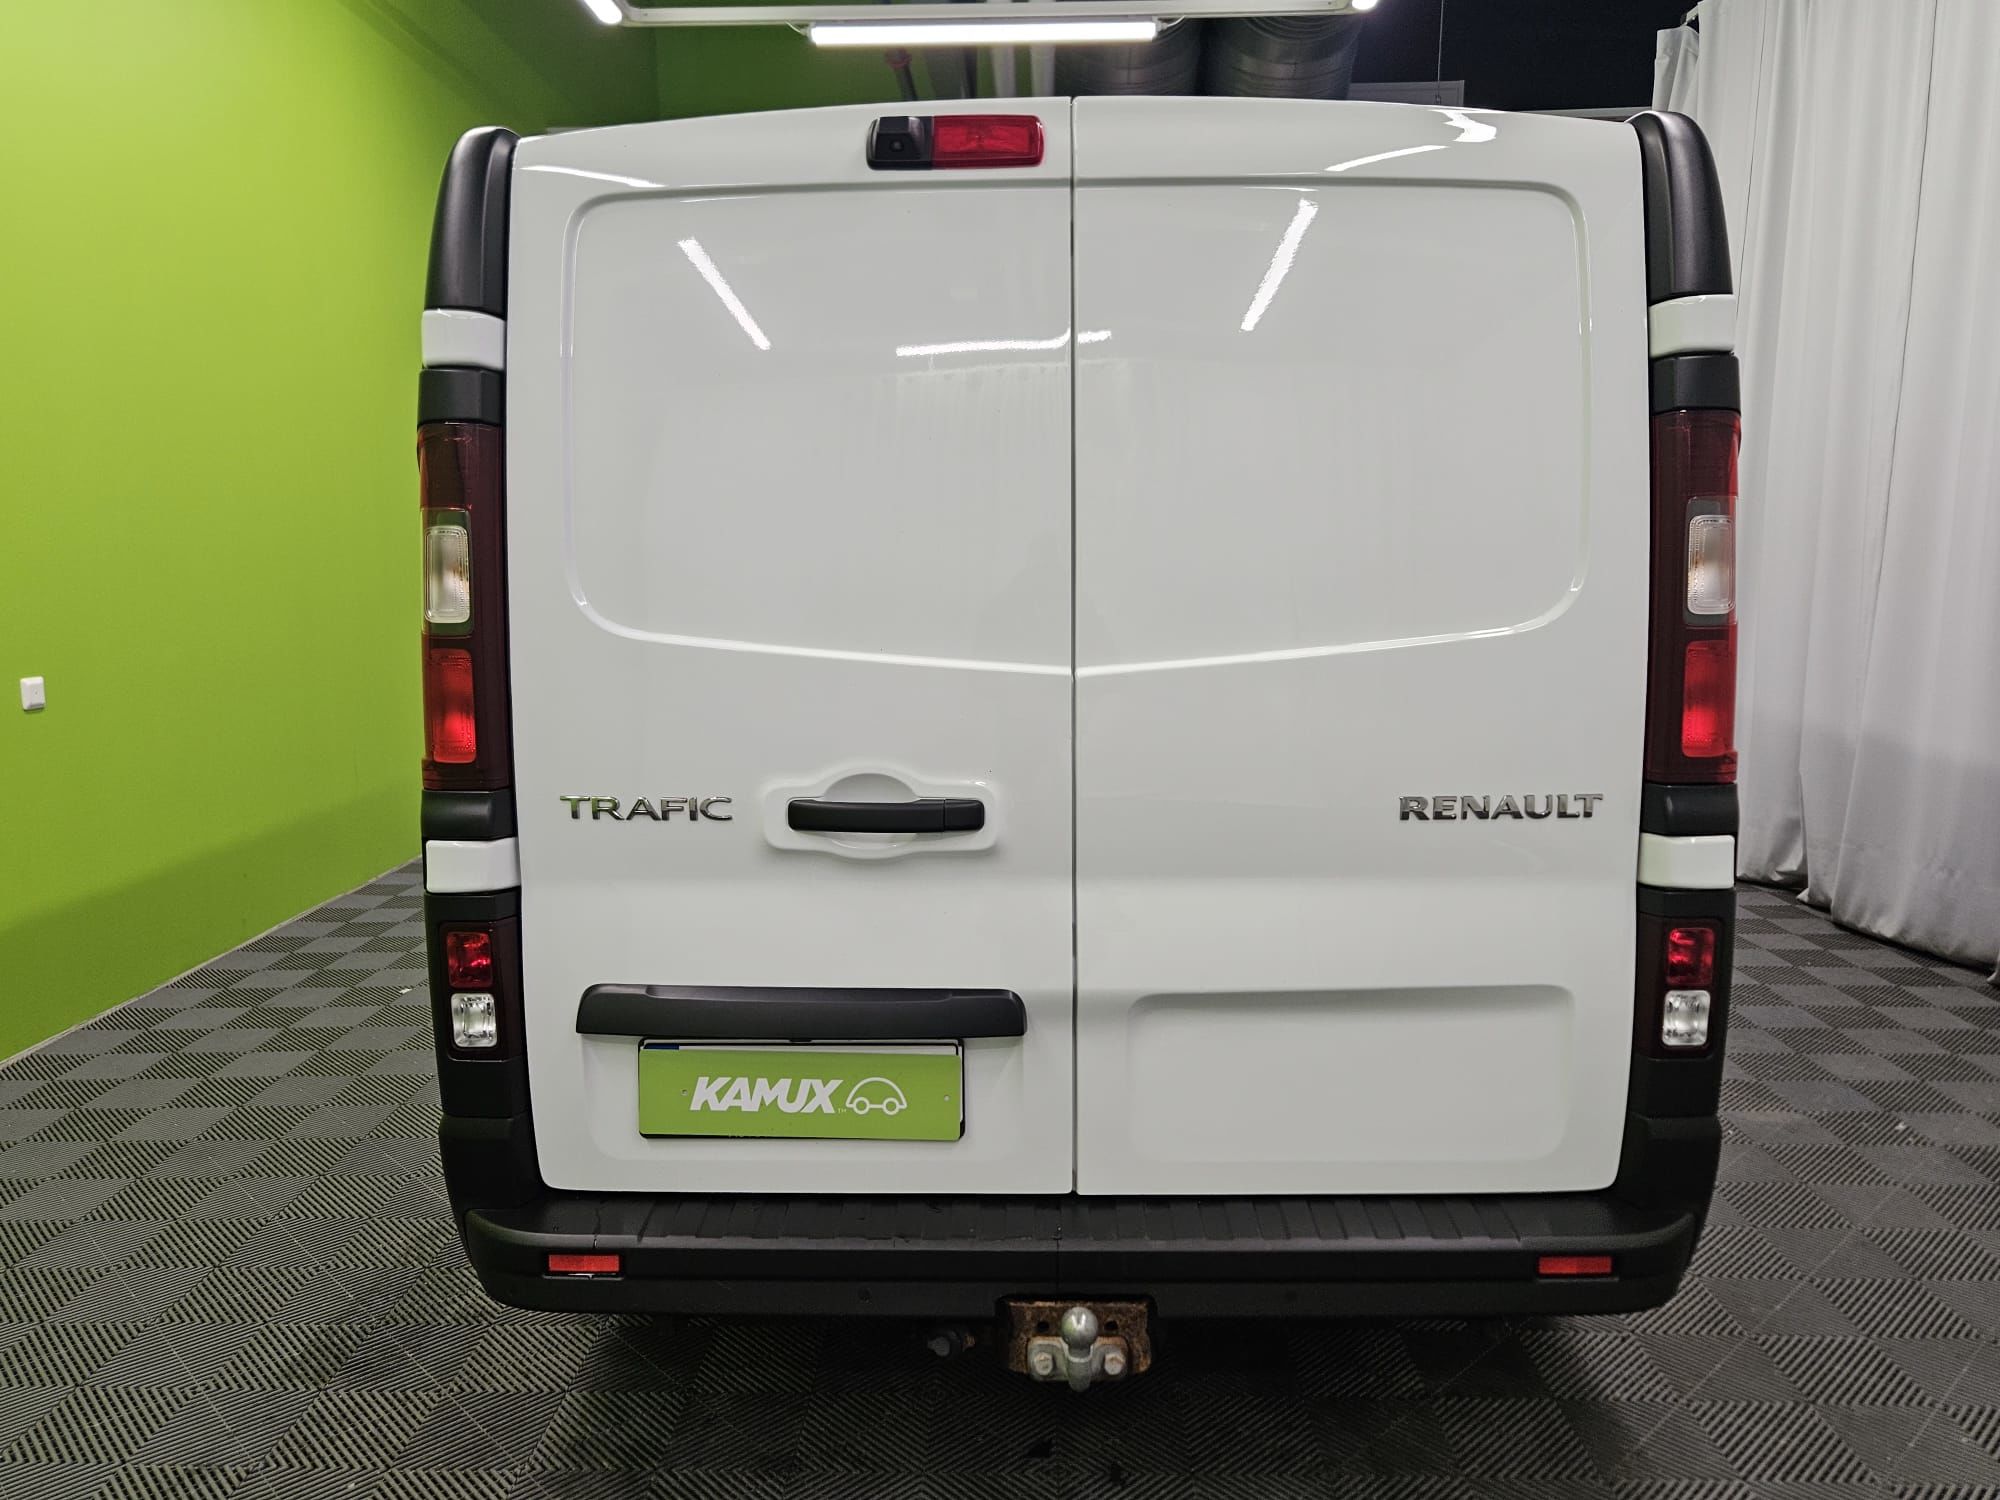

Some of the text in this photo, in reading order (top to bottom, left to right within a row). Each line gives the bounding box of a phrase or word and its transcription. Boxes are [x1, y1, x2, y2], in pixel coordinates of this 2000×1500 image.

[560, 795, 733, 821] TRAFIC
[1399, 794, 1603, 820] RENAULT
[690, 1076, 843, 1113] KAMUX
